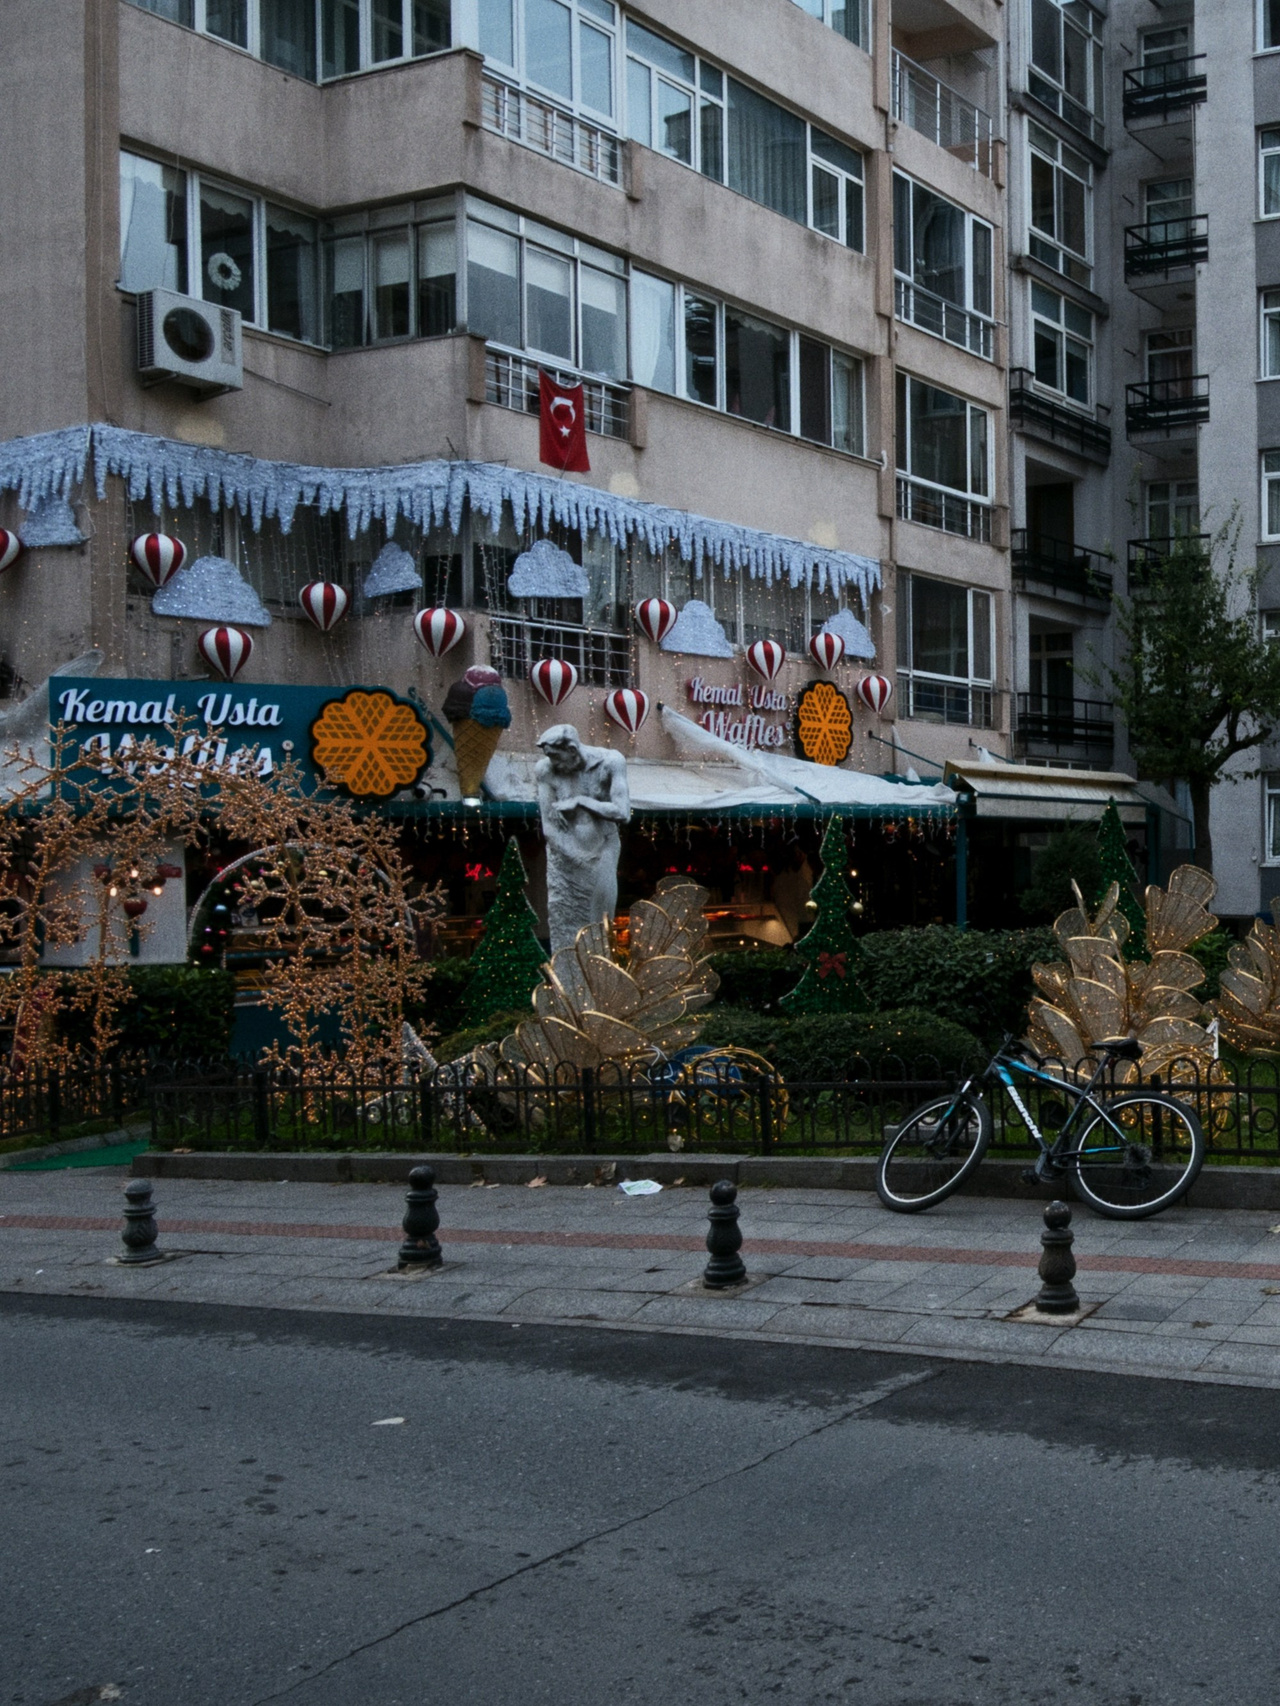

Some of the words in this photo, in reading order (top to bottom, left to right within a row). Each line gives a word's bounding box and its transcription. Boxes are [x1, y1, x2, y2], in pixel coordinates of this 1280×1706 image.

[59, 688, 177, 724] Kemal
[197, 693, 284, 727] Usta
[690, 677, 743, 706] Kemal
[751, 684, 787, 711] Usta
[703, 710, 786, 749] Waffles
